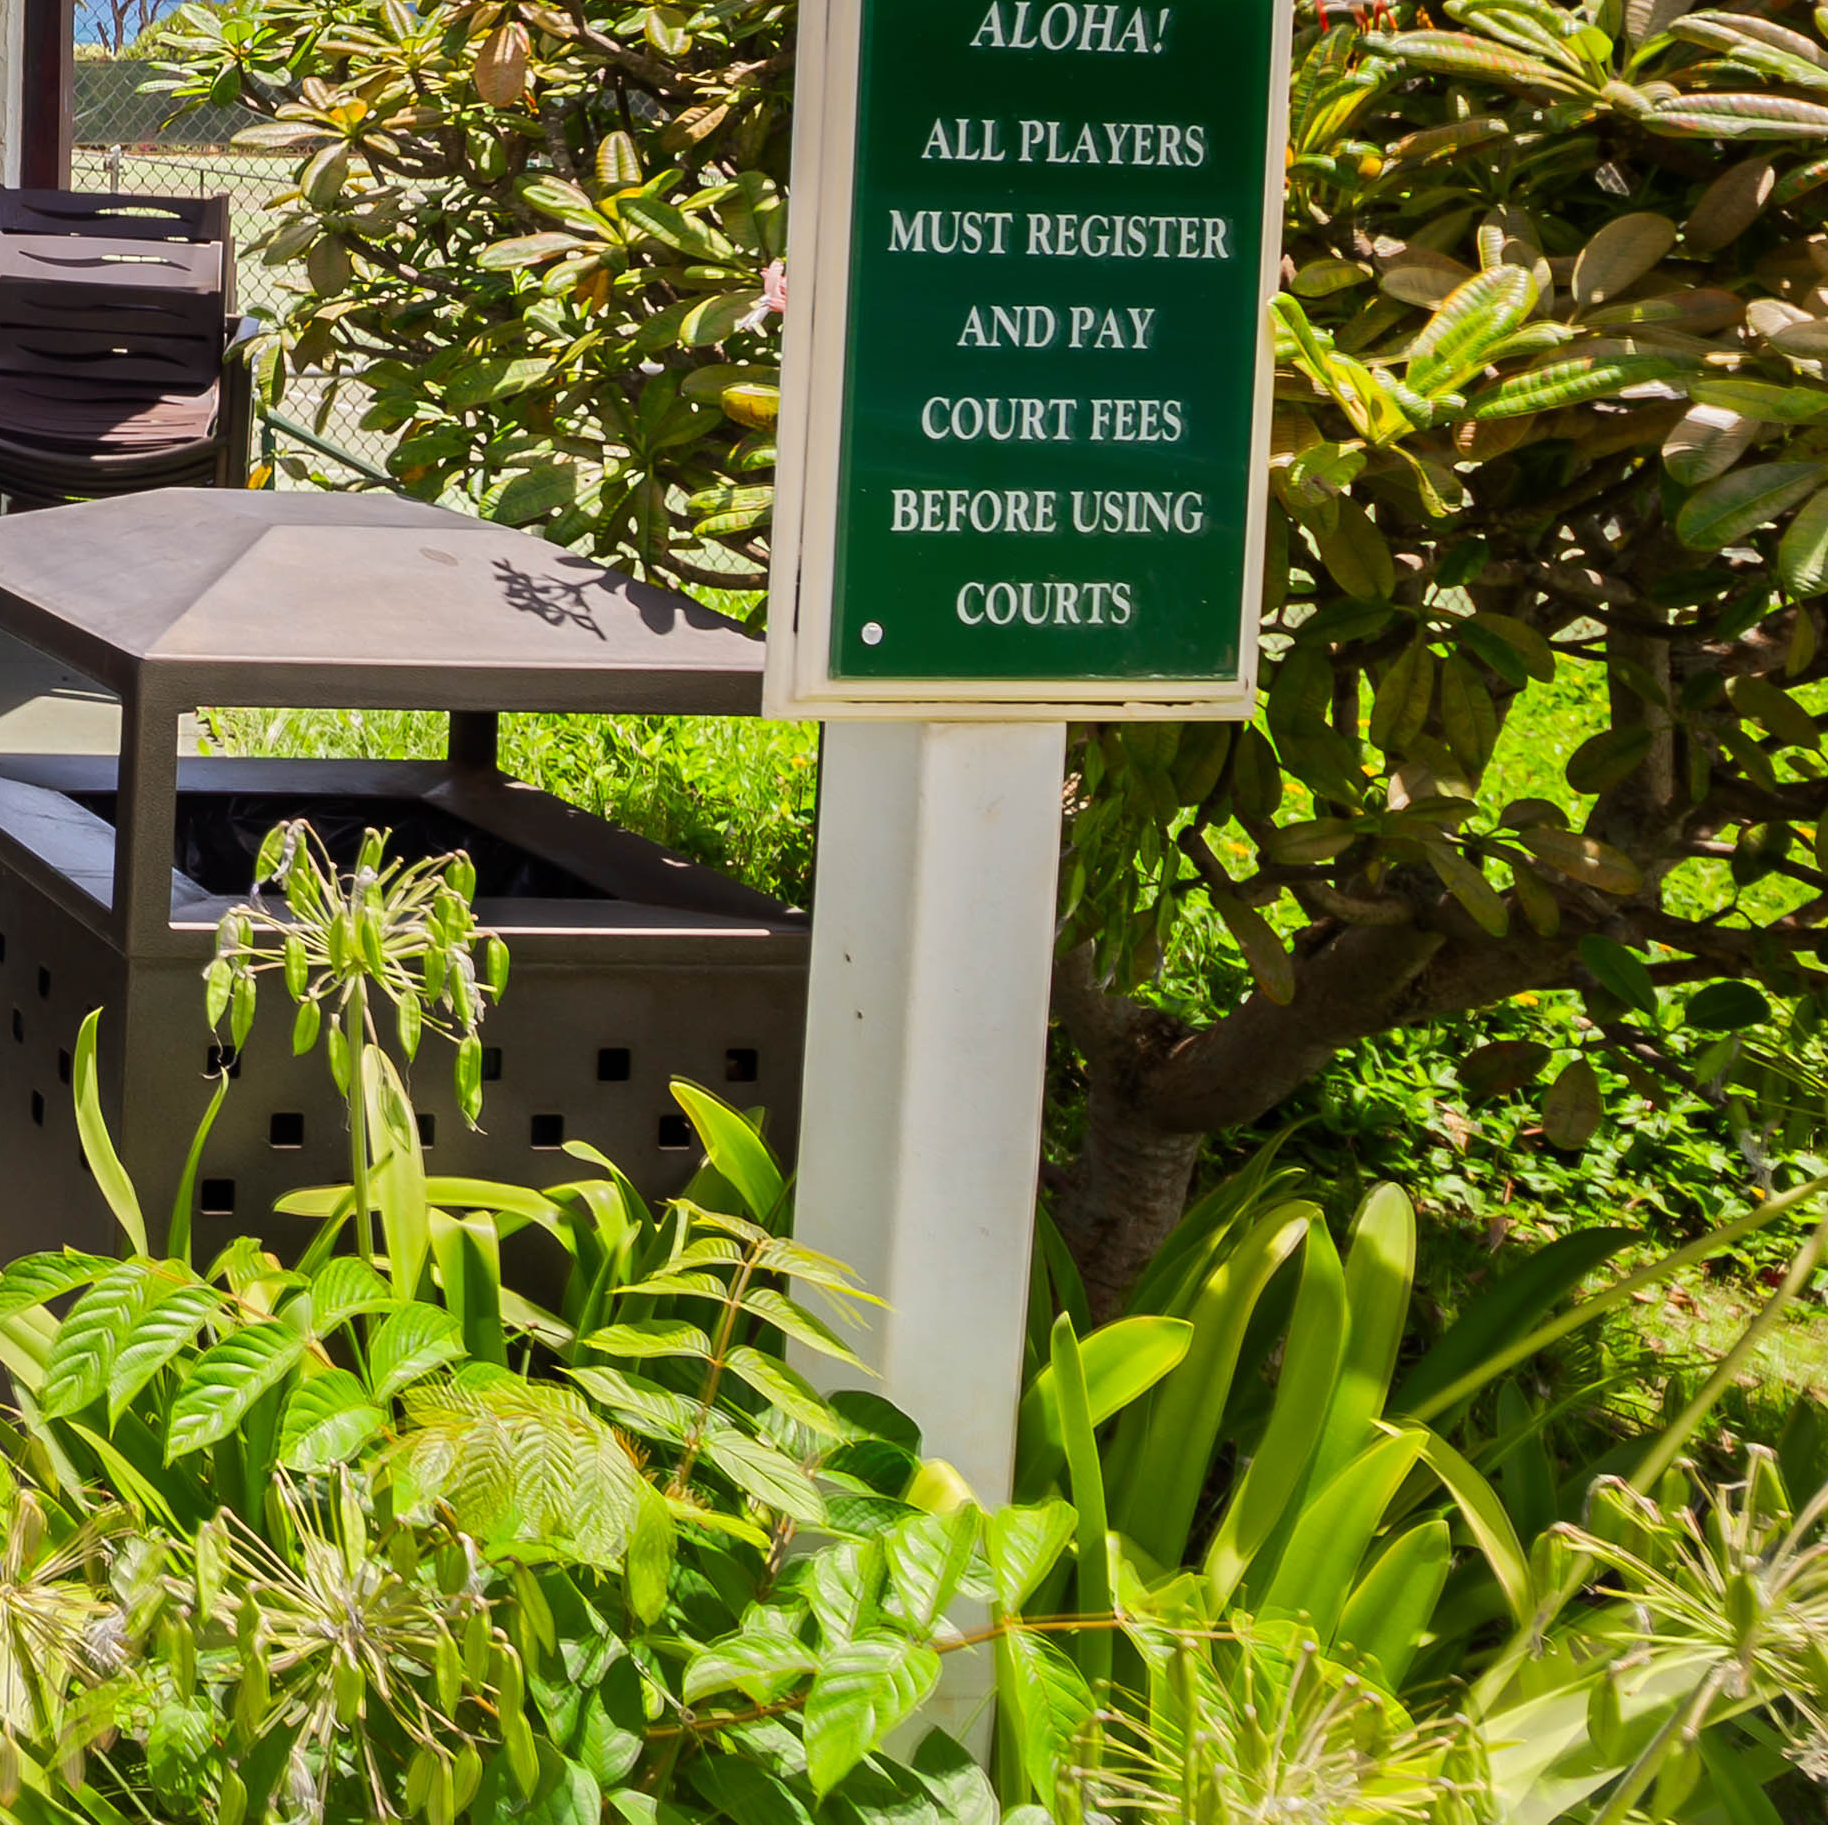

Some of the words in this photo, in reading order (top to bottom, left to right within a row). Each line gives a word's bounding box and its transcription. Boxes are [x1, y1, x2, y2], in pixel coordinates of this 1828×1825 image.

[968, 0, 1171, 54] ALOHA!
[920, 117, 1007, 163] ALL
[1018, 119, 1205, 168] PLAYERS
[887, 209, 1014, 255] MUST
[1025, 213, 1230, 260] REGISTER
[956, 304, 1056, 349] AND
[1068, 306, 1156, 351] PAY
[921, 395, 1078, 442] COURT
[1089, 398, 1183, 443] FEES
[890, 488, 1057, 534] BEFORE
[1070, 490, 1205, 535] USING
[956, 580, 1132, 626] COURTS
